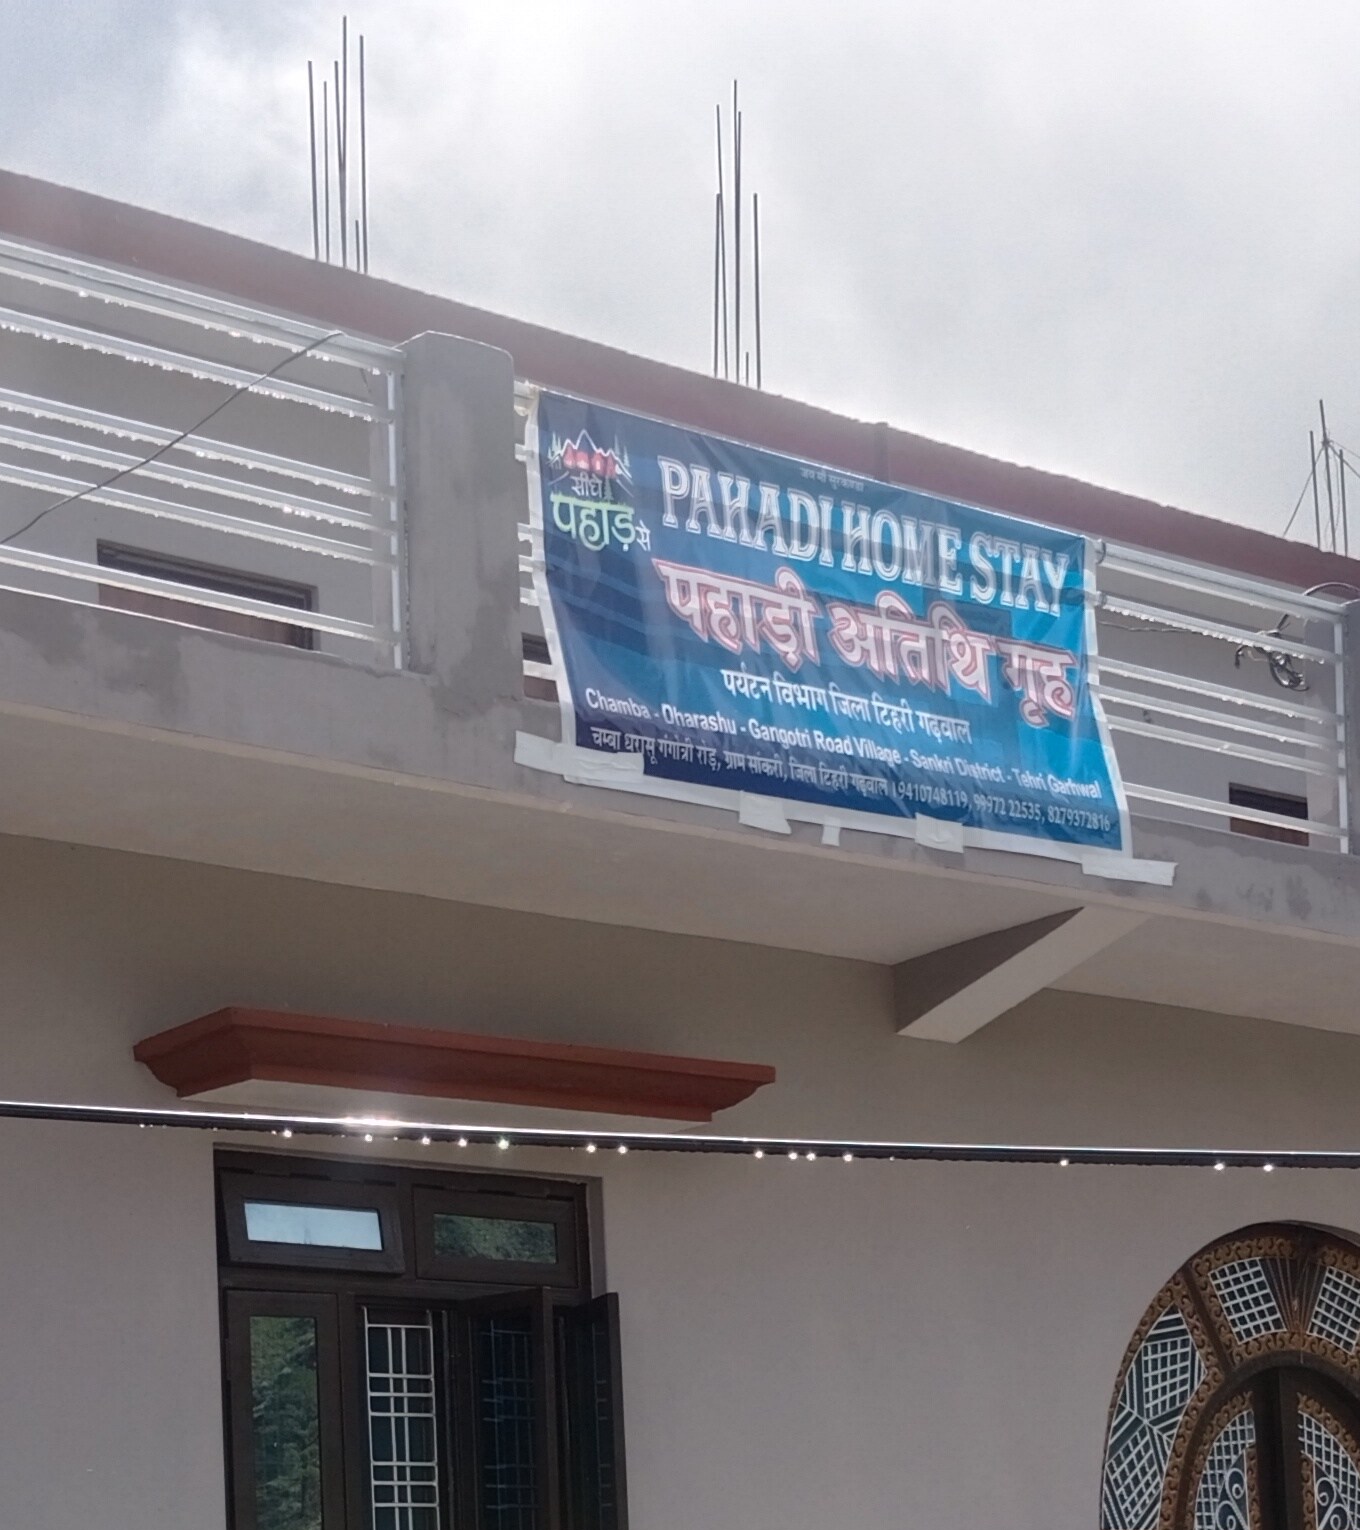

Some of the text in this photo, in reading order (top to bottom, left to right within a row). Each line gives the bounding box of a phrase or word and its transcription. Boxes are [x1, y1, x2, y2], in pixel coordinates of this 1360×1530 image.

[549, 492, 651, 552] पहाड़ से
[657, 455, 1070, 618] PAHADI HOME STAY
[651, 557, 1079, 729] पहाड़ी अतिथि गृह
[720, 661, 773, 703] पर्यटन
[772, 671, 829, 713] विभाग
[829, 681, 872, 724] जिला
[871, 691, 916, 735] टिहरी
[585, 687, 652, 720] Chamba
[661, 703, 737, 735] Dharashu
[747, 718, 812, 750] Gangotri
[813, 729, 854, 756] Road
[852, 736, 902, 768] Village
[909, 748, 953, 774] Sankri
[954, 756, 1006, 784] District
[1011, 768, 1048, 791] Tehri
[1047, 773, 1102, 799] Garhwal
